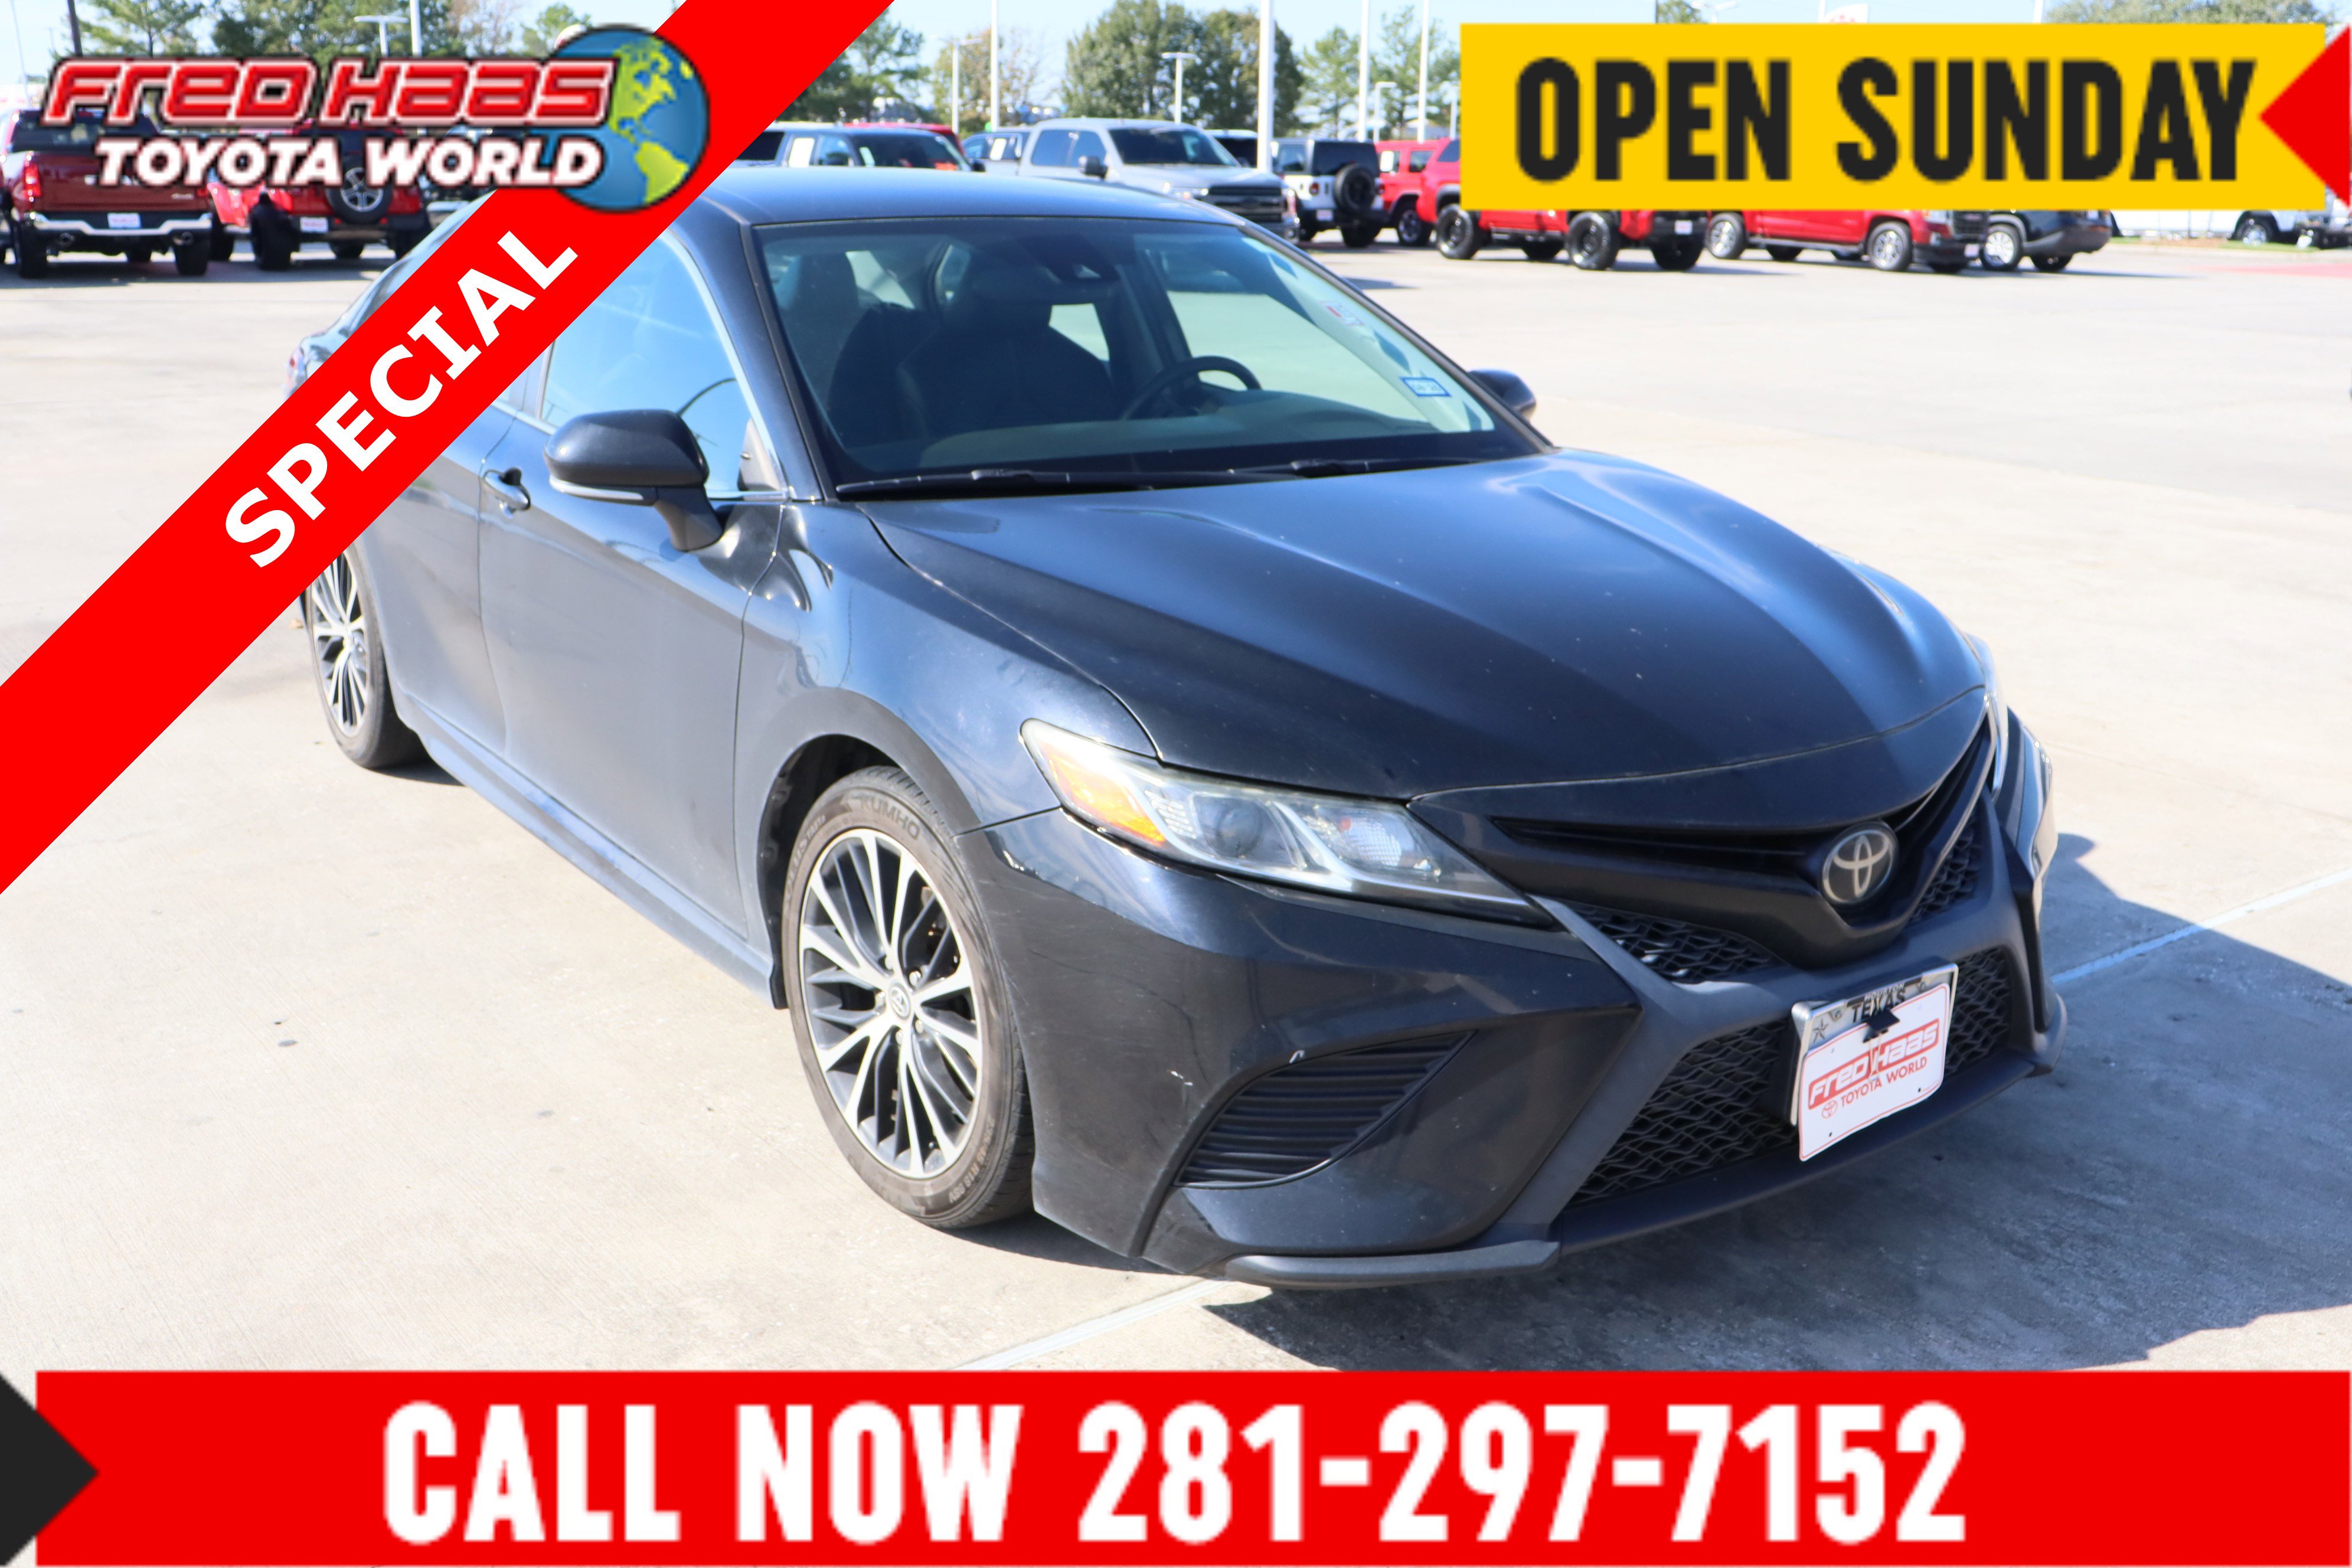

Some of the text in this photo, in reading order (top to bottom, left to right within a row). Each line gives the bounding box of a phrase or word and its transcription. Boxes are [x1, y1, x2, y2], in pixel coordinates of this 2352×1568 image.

[860, 795, 920, 841] KUMHO
[1851, 988, 1906, 1023] TEXAS
[1841, 1056, 1927, 1108] TOYOTA WORLD
